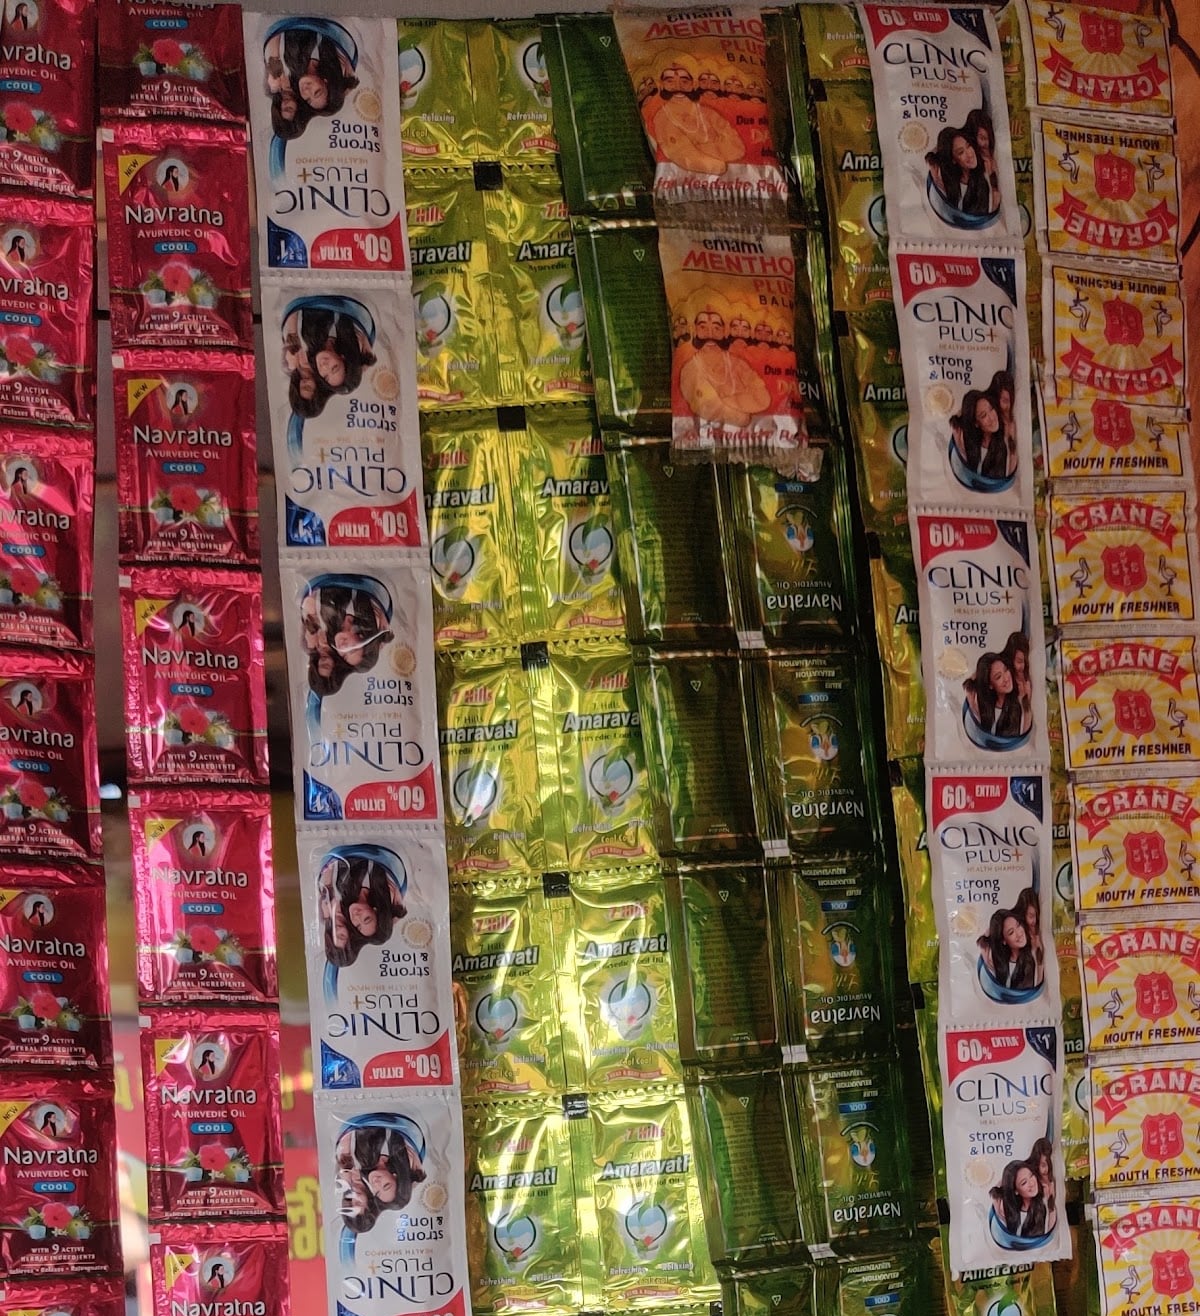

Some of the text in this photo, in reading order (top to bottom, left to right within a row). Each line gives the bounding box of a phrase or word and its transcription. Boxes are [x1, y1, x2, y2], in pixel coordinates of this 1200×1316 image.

[883, 38, 987, 73] CLINIC
[1057, 71, 1154, 96] CRANE
[900, 94, 947, 109] strong
[902, 104, 947, 122] & long
[331, 120, 379, 137] & long
[329, 135, 381, 153] strong
[1055, 128, 1160, 150] MOUTH FRESHNER
[276, 184, 390, 217] CLINIC
[125, 204, 224, 226] Navratna
[1070, 214, 1164, 242] CRANE
[161, 242, 190, 251] COOL
[354, 233, 392, 261] 60%
[703, 236, 764, 253] emami
[909, 262, 946, 284] 60%
[913, 295, 1014, 329] CLINIC
[134, 426, 232, 446] Navratna
[145, 449, 219, 460] AYURVEDIC OIL
[1064, 456, 1168, 469] MOUTH FRESHNER
[170, 464, 198, 473] COOL
[291, 467, 406, 496] CLINIC
[372, 511, 408, 537] 60%
[1069, 504, 1165, 531] CRANE
[929, 527, 964, 547] 60%
[928, 560, 1028, 589] CLINIC
[1072, 601, 1180, 616] MOUTH FRESHNER
[942, 620, 987, 634] strong
[944, 632, 986, 648] & long
[142, 647, 238, 669] Navratna
[1078, 650, 1175, 676] CRANE
[178, 686, 205, 694] COOL
[0, 726, 74, 748] avratna
[310, 741, 424, 772] CLINIC
[1085, 743, 1191, 759] MOUTH FRESHNER
[942, 785, 974, 809] 60%
[941, 821, 1037, 849] CLINIC
[154, 867, 247, 888] Navratna
[956, 878, 1000, 891] strong
[1097, 885, 1200, 902] MOUTH FRESHNER
[188, 905, 216, 913] COOL
[1103, 931, 1194, 959] CRANE
[382, 950, 417, 964] long
[453, 947, 539, 972] Amaravati
[199, 969, 207, 979] 9
[380, 964, 429, 977] strong
[811, 1006, 880, 1023] Navratna
[328, 1011, 439, 1041] CLINIC
[957, 1039, 991, 1061] 60%
[405, 1054, 441, 1077] 60%
[162, 1085, 256, 1104] Navratna
[956, 1072, 1053, 1102] CLINIC
[969, 1130, 1014, 1144] strong
[4, 1147, 97, 1165] Navratna
[17, 1168, 88, 1178] AYURVEDIC OIL
[601, 1155, 690, 1180] Amaravati
[41, 1183, 68, 1191] COOL
[471, 1167, 557, 1191] Amaravati
[344, 1272, 454, 1303] CLINIC
[172, 1299, 265, 1316] Navratna
